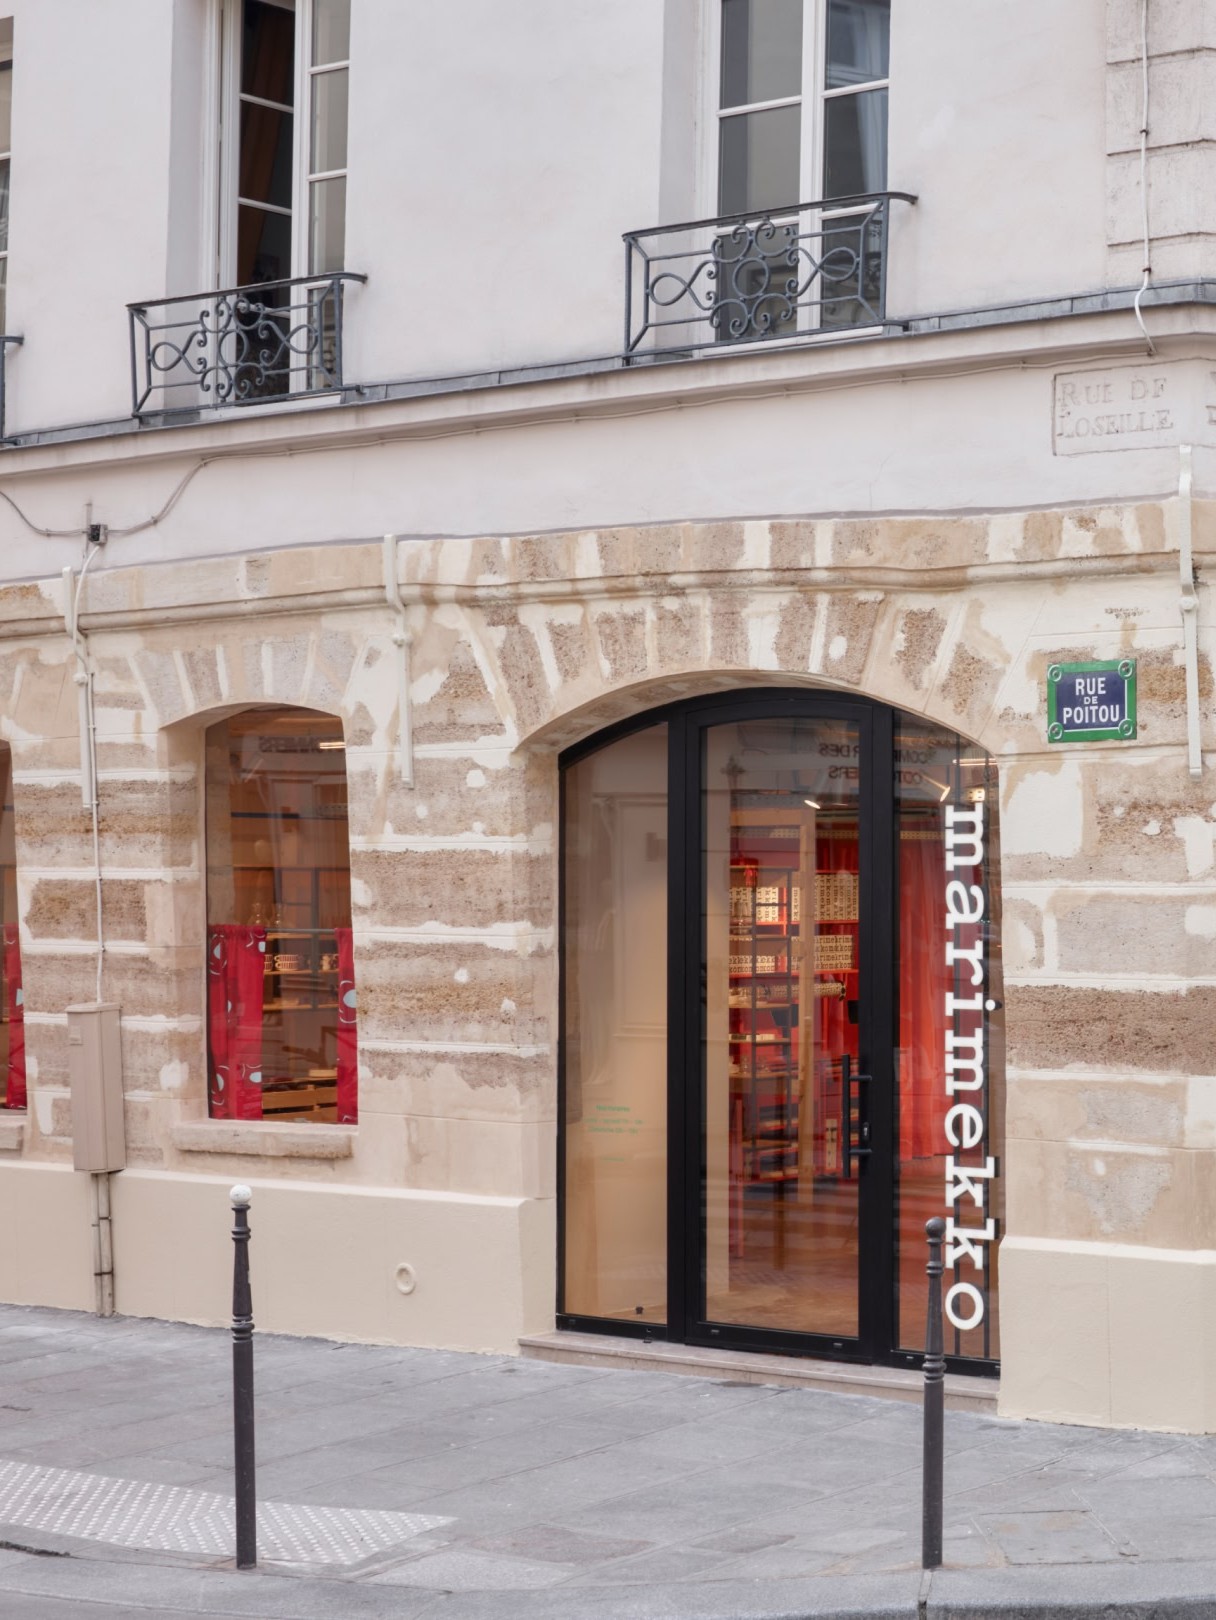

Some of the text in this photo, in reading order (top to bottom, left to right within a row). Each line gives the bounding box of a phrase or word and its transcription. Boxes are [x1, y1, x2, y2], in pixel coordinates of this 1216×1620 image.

[1075, 677, 1106, 696] RUE
[1083, 696, 1098, 705] DE
[1063, 704, 1119, 725] POITOU
[945, 803, 996, 1331] marimekko
